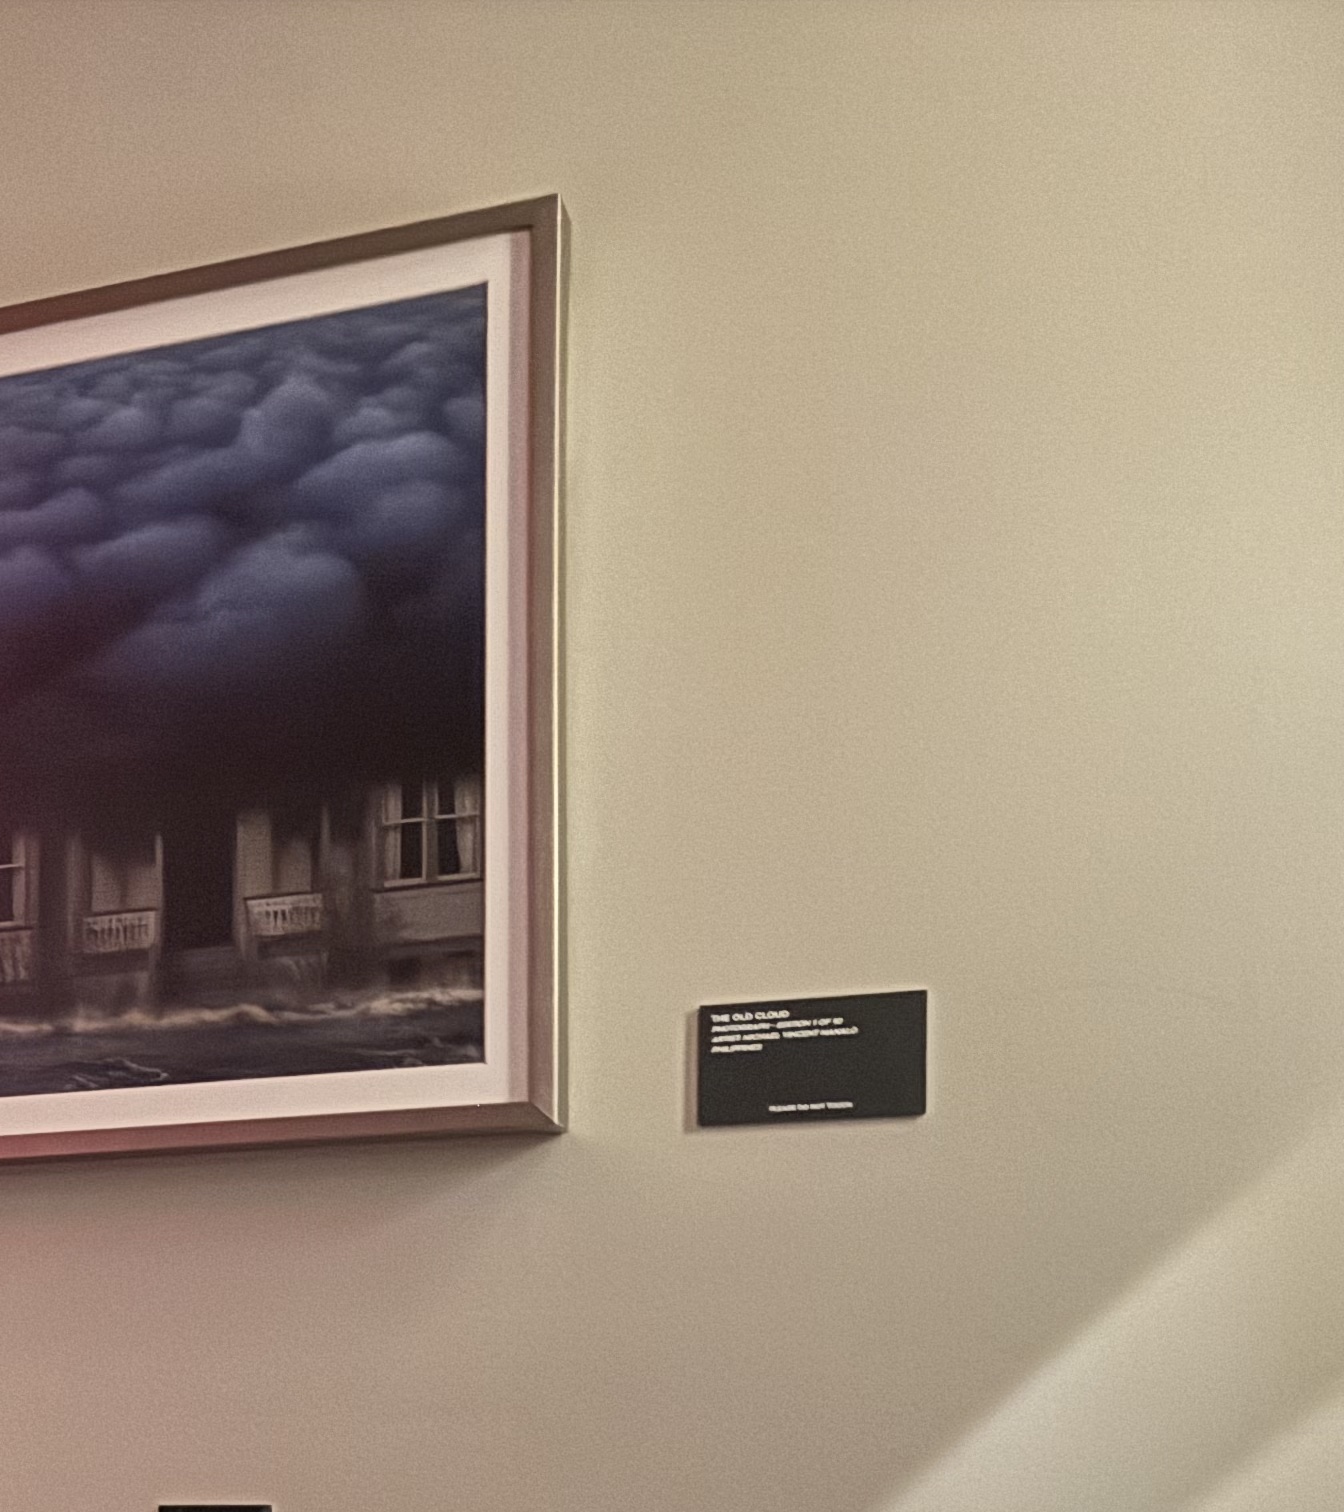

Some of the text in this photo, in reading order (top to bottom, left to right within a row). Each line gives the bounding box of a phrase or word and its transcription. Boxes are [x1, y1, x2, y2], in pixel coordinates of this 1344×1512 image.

[710, 1009, 790, 1023] THE OLD CLOUD
